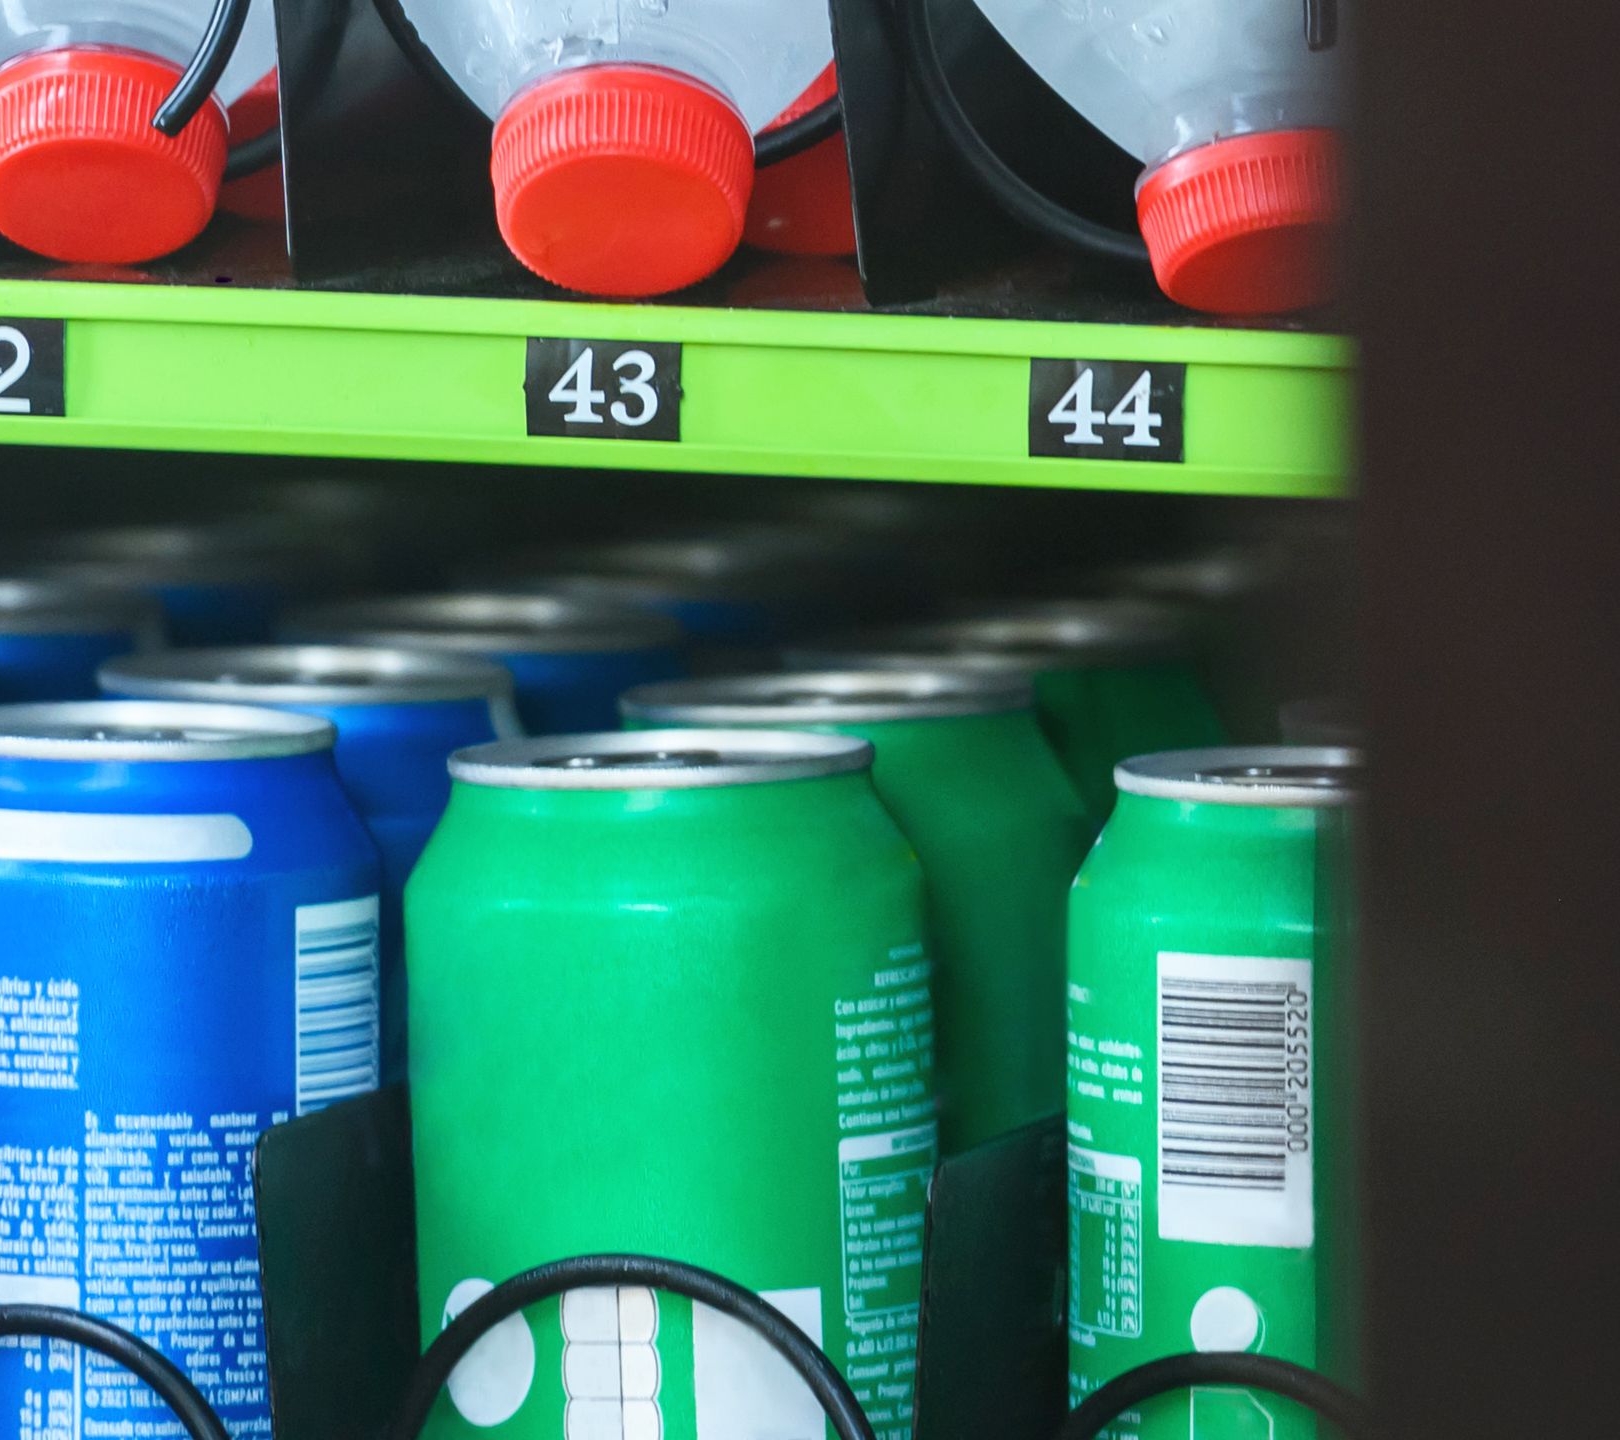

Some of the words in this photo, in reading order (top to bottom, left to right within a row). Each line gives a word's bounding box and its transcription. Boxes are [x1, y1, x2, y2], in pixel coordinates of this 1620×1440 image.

[549, 347, 657, 425] 43
[1049, 369, 1161, 445] 44
[217, 1388, 264, 1406] COMPANY
